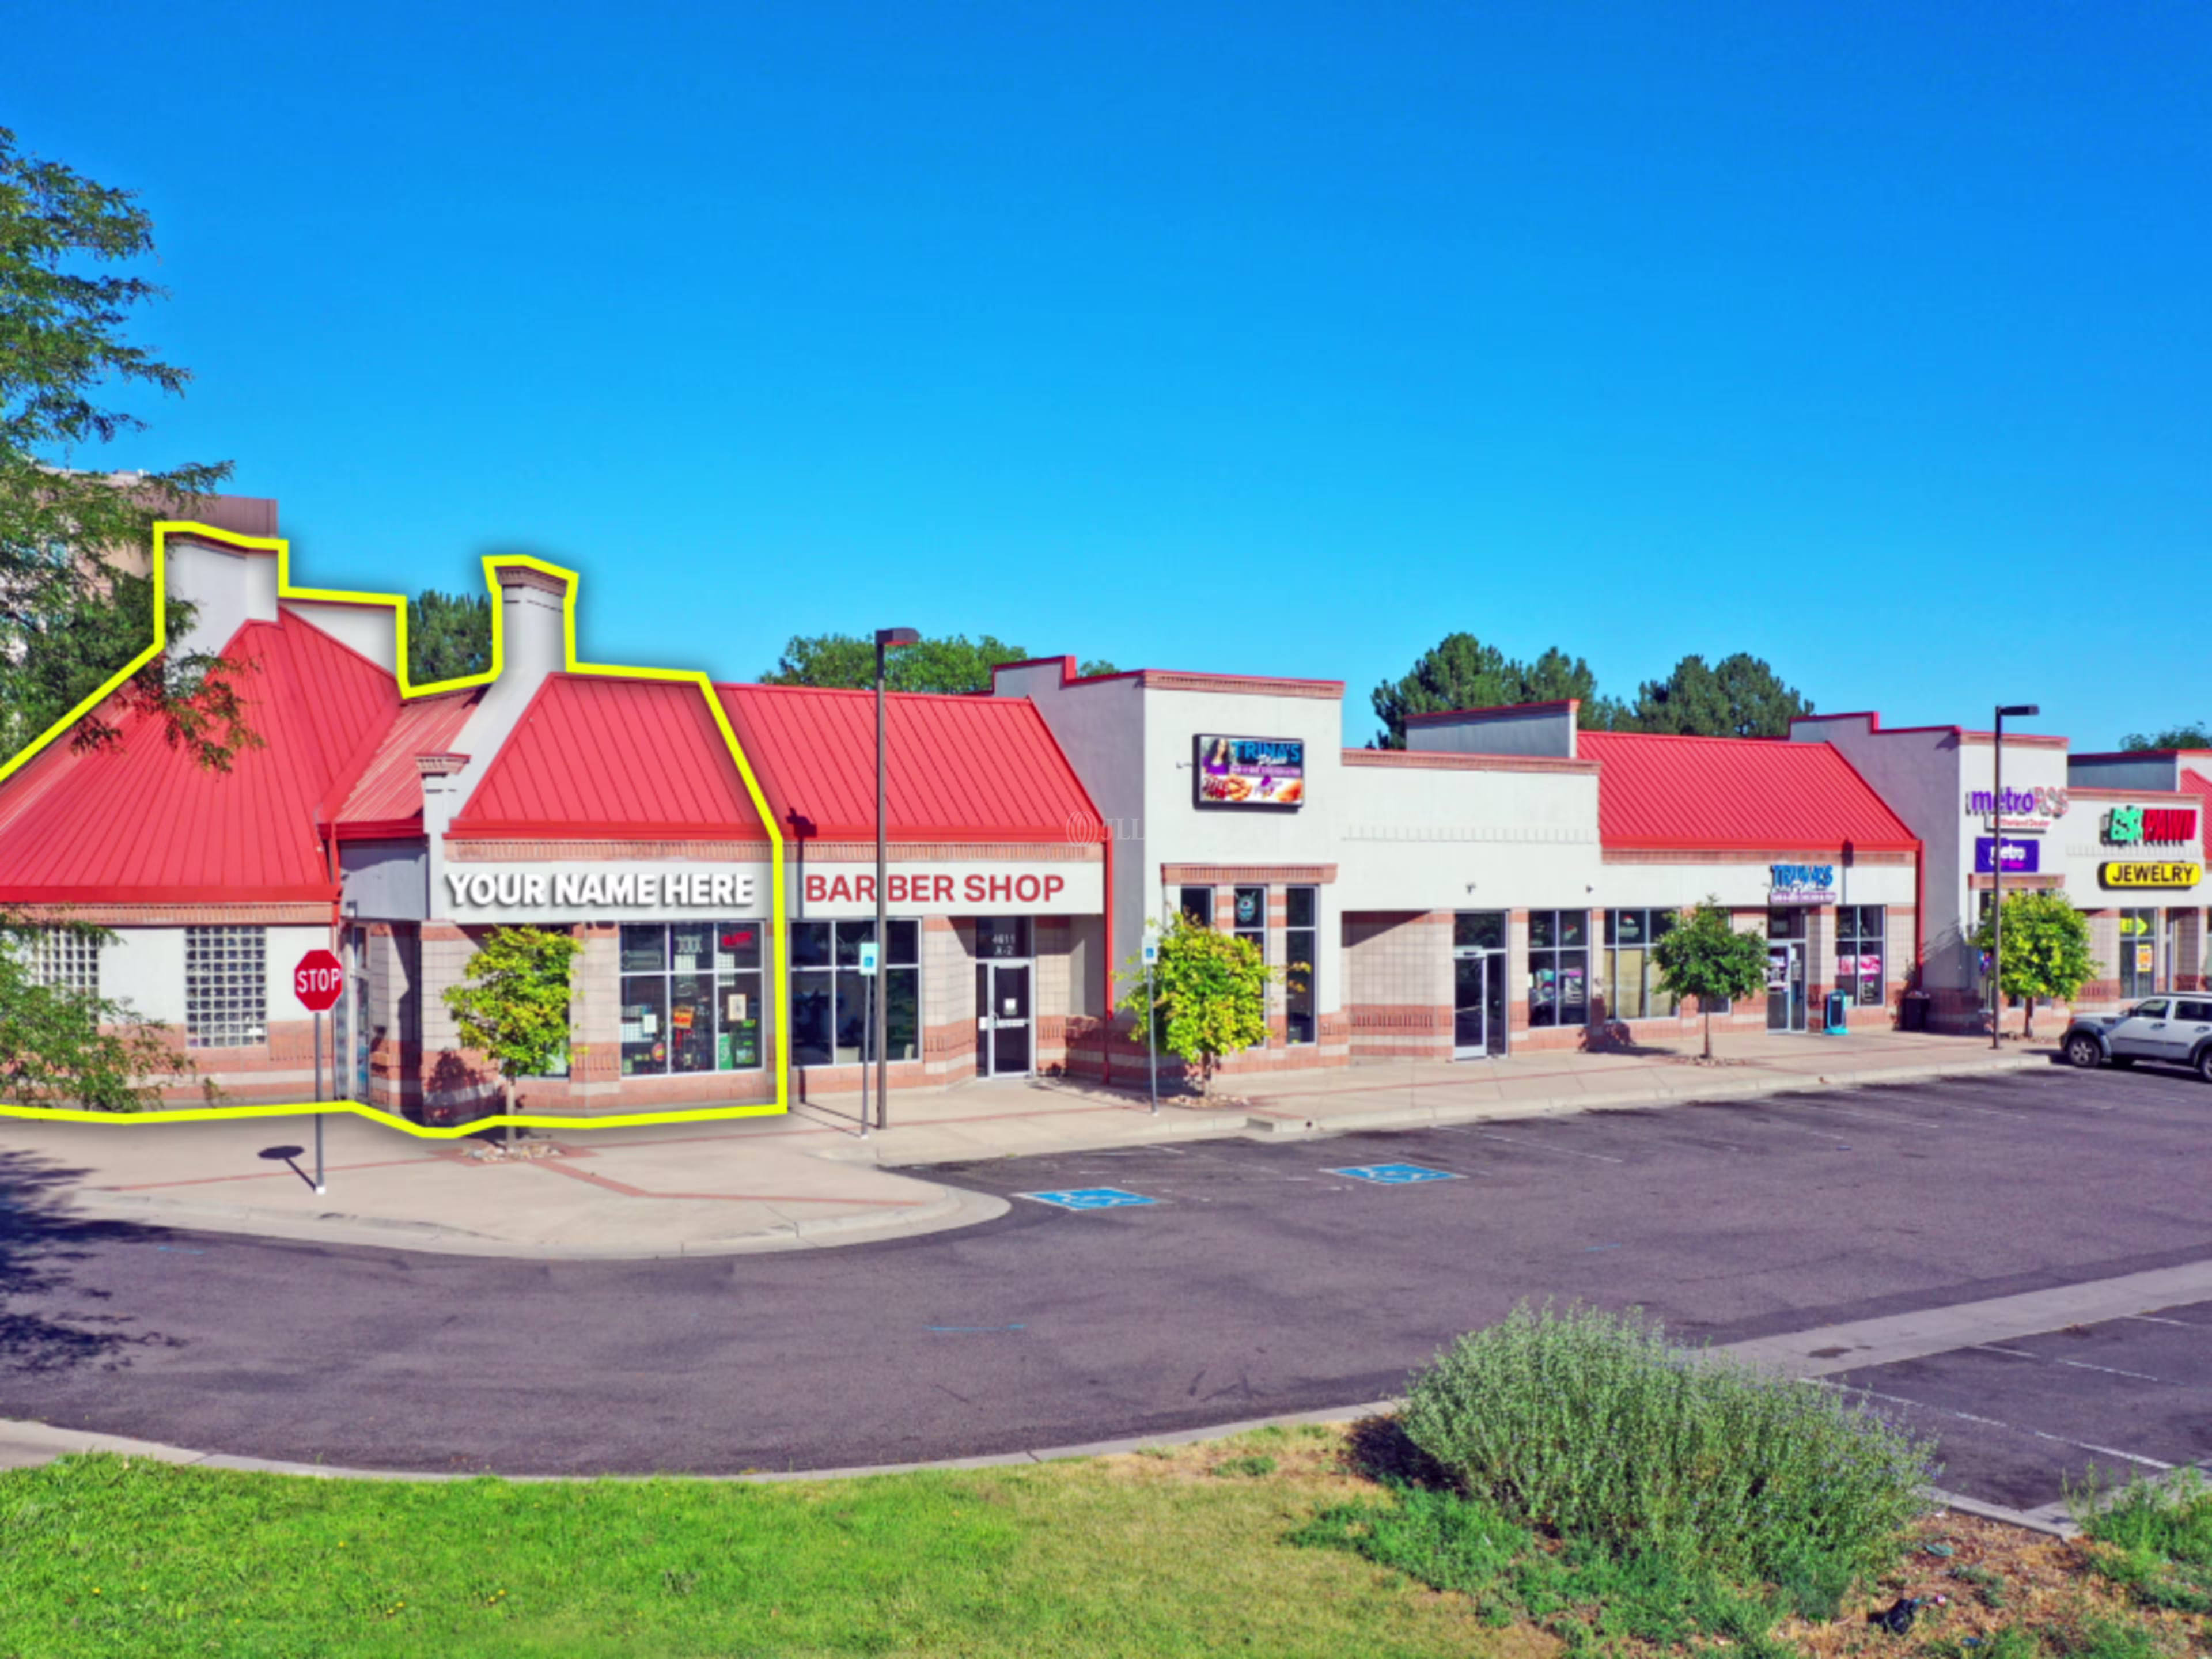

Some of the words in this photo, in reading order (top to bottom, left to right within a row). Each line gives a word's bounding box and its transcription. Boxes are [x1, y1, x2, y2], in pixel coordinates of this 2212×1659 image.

[2142, 809, 2197, 840] PAWN
[2112, 865, 2194, 882] JEWELRY
[805, 874, 955, 902] BARBER
[964, 874, 1065, 902] SHOP
[297, 968, 343, 993] STOP
